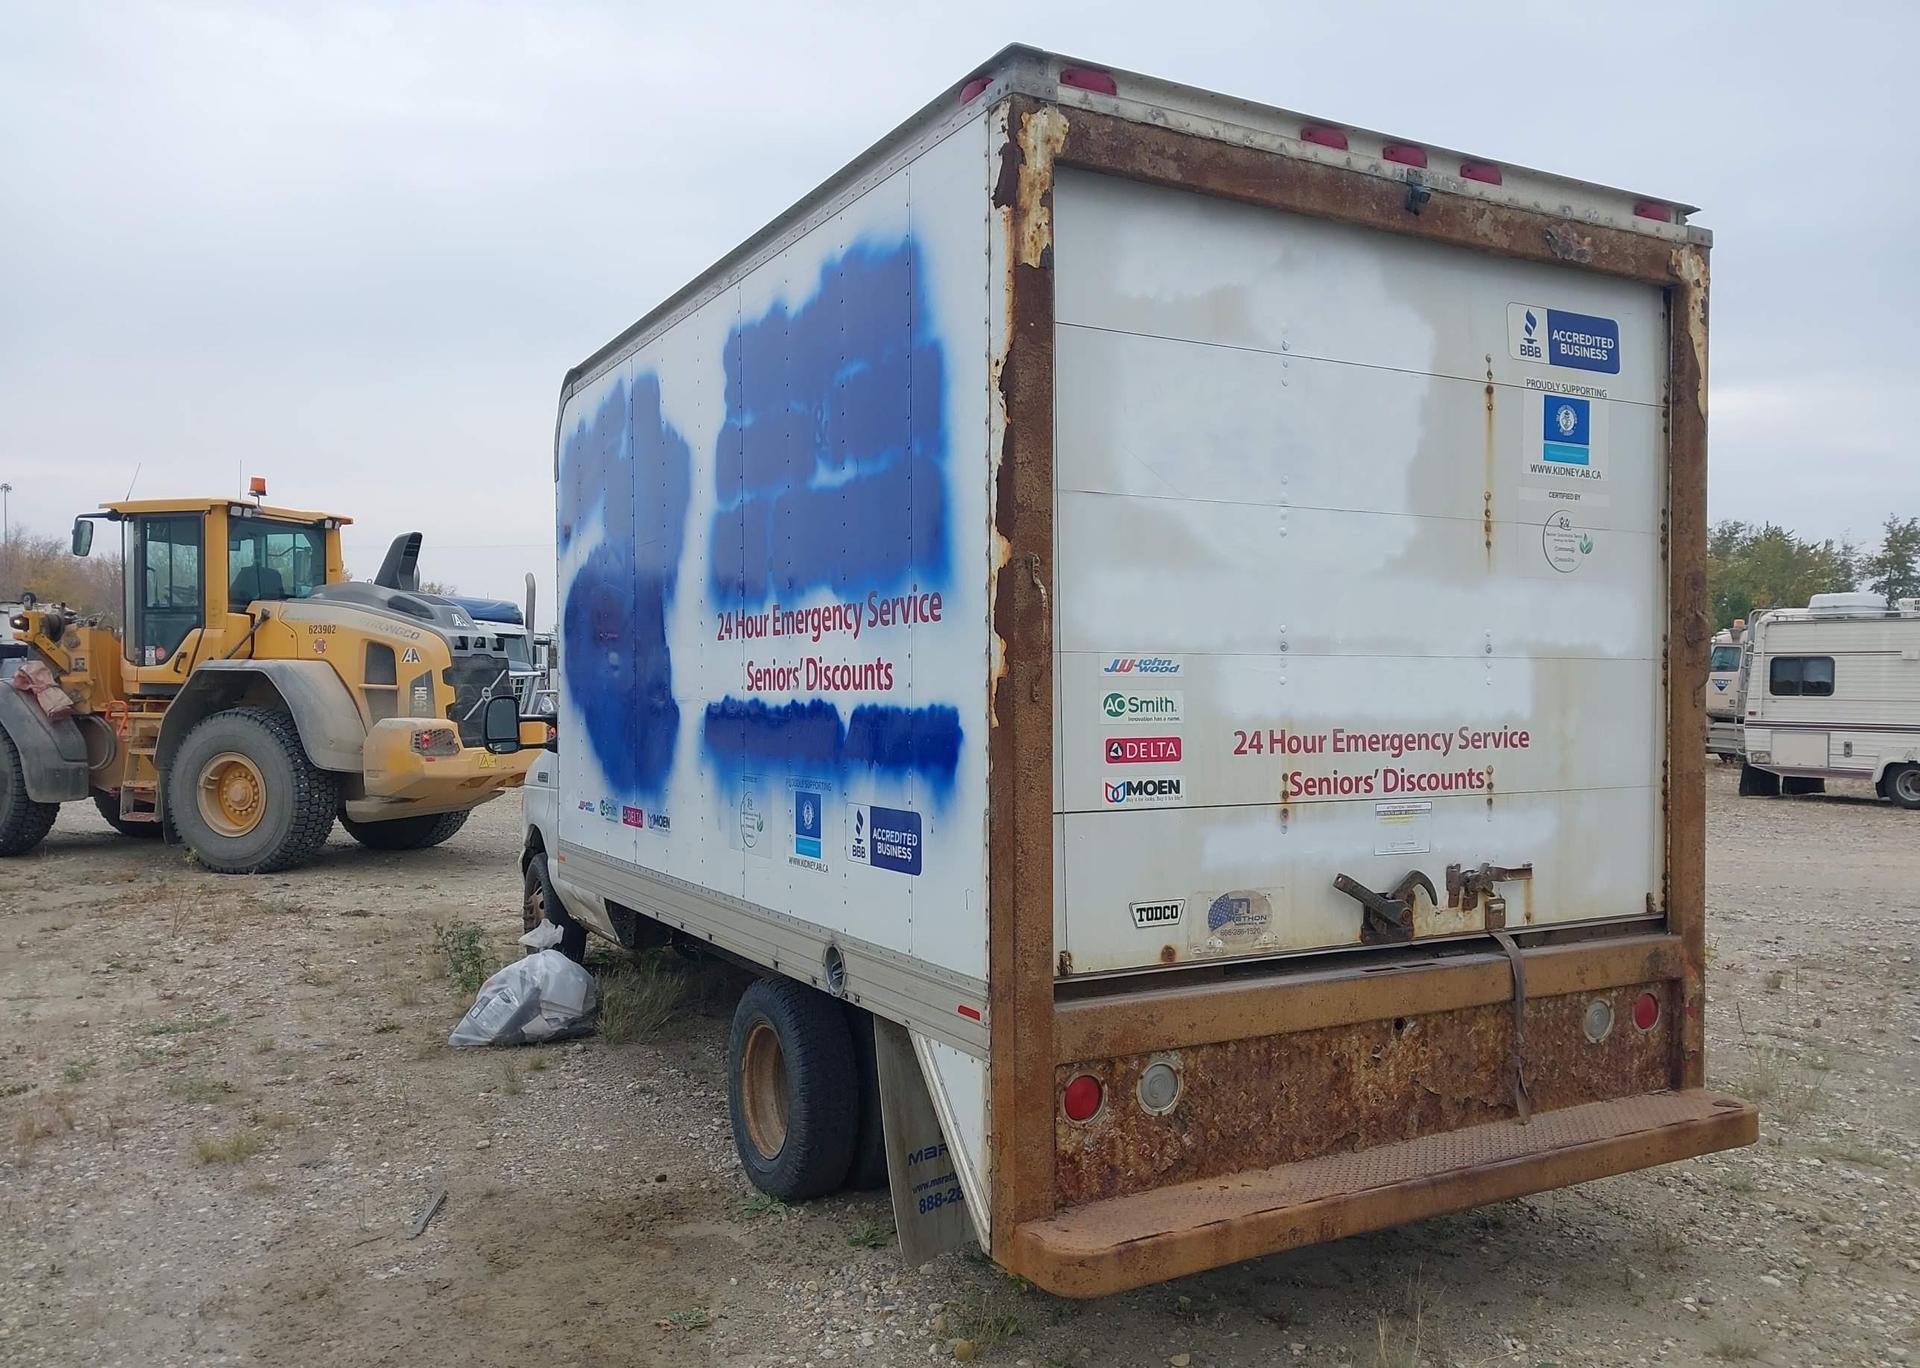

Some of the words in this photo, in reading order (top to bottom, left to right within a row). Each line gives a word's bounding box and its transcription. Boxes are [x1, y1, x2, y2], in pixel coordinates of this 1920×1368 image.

[1552, 329, 1615, 349] ACCREDITED
[1520, 345, 1542, 358] BBB
[1560, 343, 1608, 361] BUSINESS
[1526, 378, 1560, 391] PROUDLY
[1561, 383, 1608, 398] SUPPORTING
[1530, 463, 1602, 481] WWW.KIDNEY.AB.CA
[717, 611, 733, 641] 24
[735, 610, 770, 640] Hour
[772, 602, 864, 642] Emergency
[867, 584, 943, 628] Service
[308, 624, 337, 635] 623902
[806, 656, 893, 691] Discounts
[1126, 742, 1177, 759] DELTA
[1233, 730, 1263, 755] 24
[1269, 729, 1327, 754] Hour
[1332, 728, 1454, 758] Emergency
[1458, 725, 1530, 750] Service
[1126, 779, 1180, 796] MOEN
[1383, 766, 1485, 793] Discounts
[872, 828, 918, 847] ACCREDITED
[852, 845, 866, 859] BBB
[877, 842, 912, 860] BUSINESS
[1136, 905, 1178, 923] TODCO
